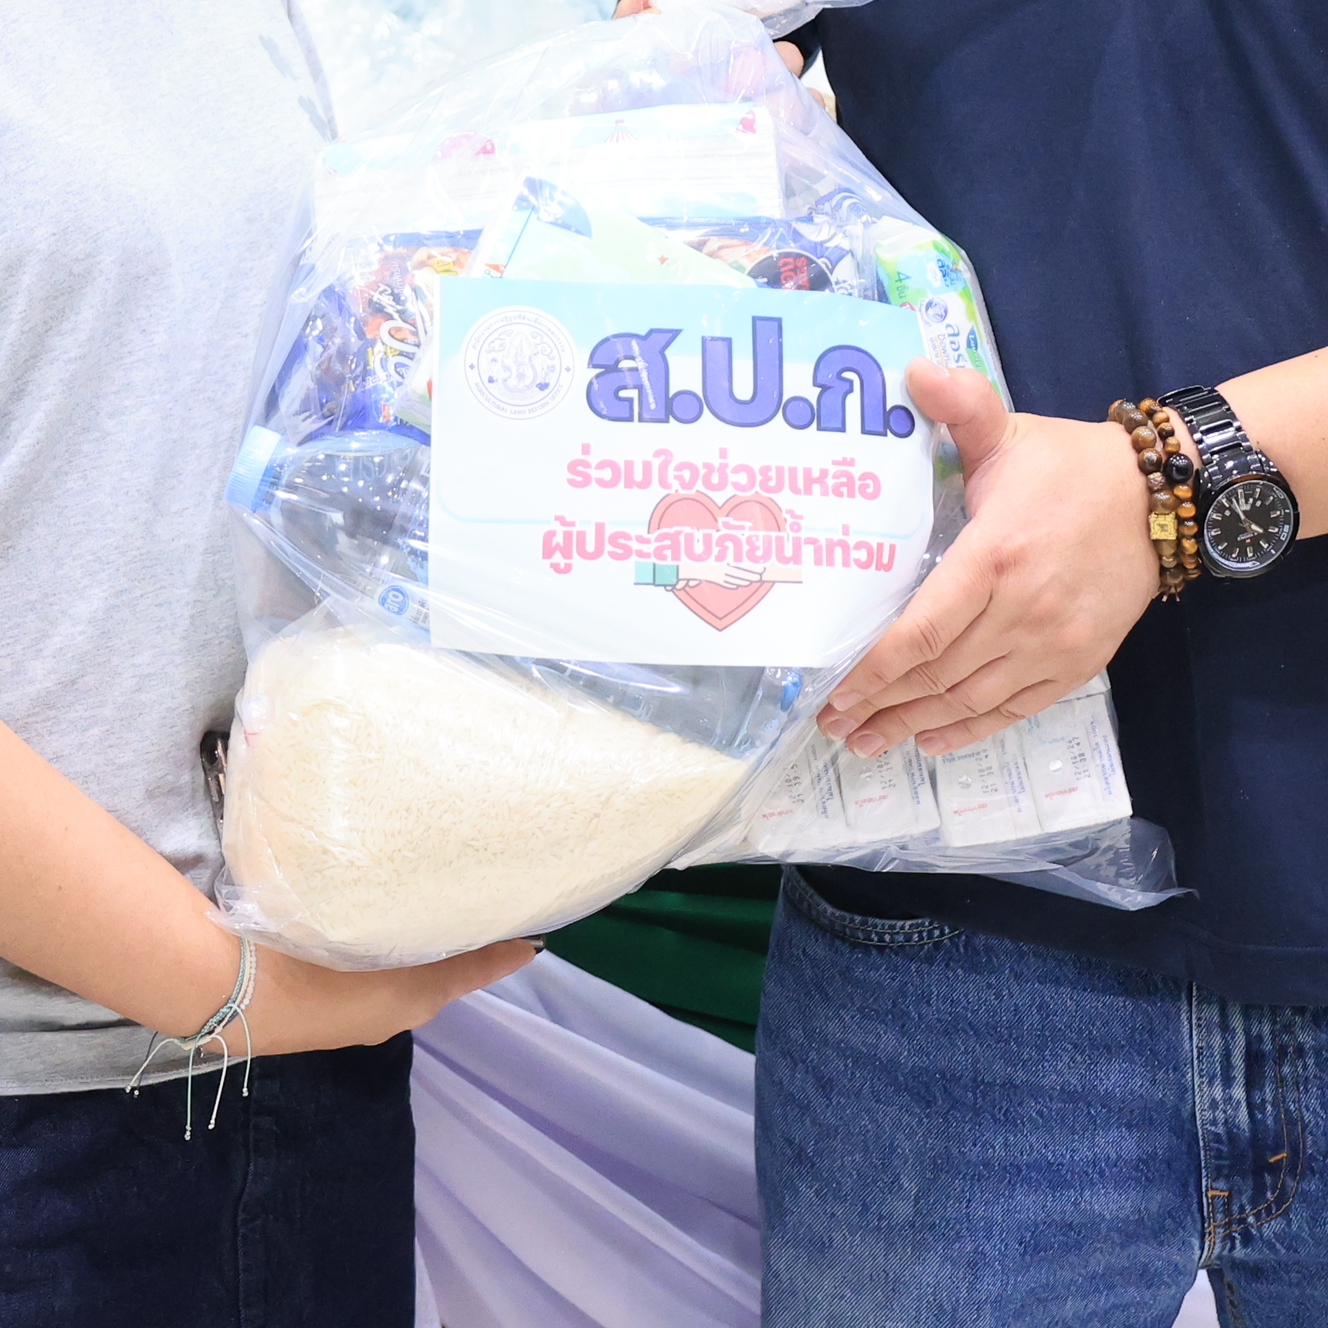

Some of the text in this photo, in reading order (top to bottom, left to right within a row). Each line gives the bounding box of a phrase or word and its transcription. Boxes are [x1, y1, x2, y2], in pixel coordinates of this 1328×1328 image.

[586, 315, 915, 438] ส.ป.ก.
[566, 443, 882, 501] ร่วมใจช่วยเหลือ
[541, 508, 897, 575] ผู้ประสบภัยน้ำท่วม
[383, 590, 405, 613] aro
